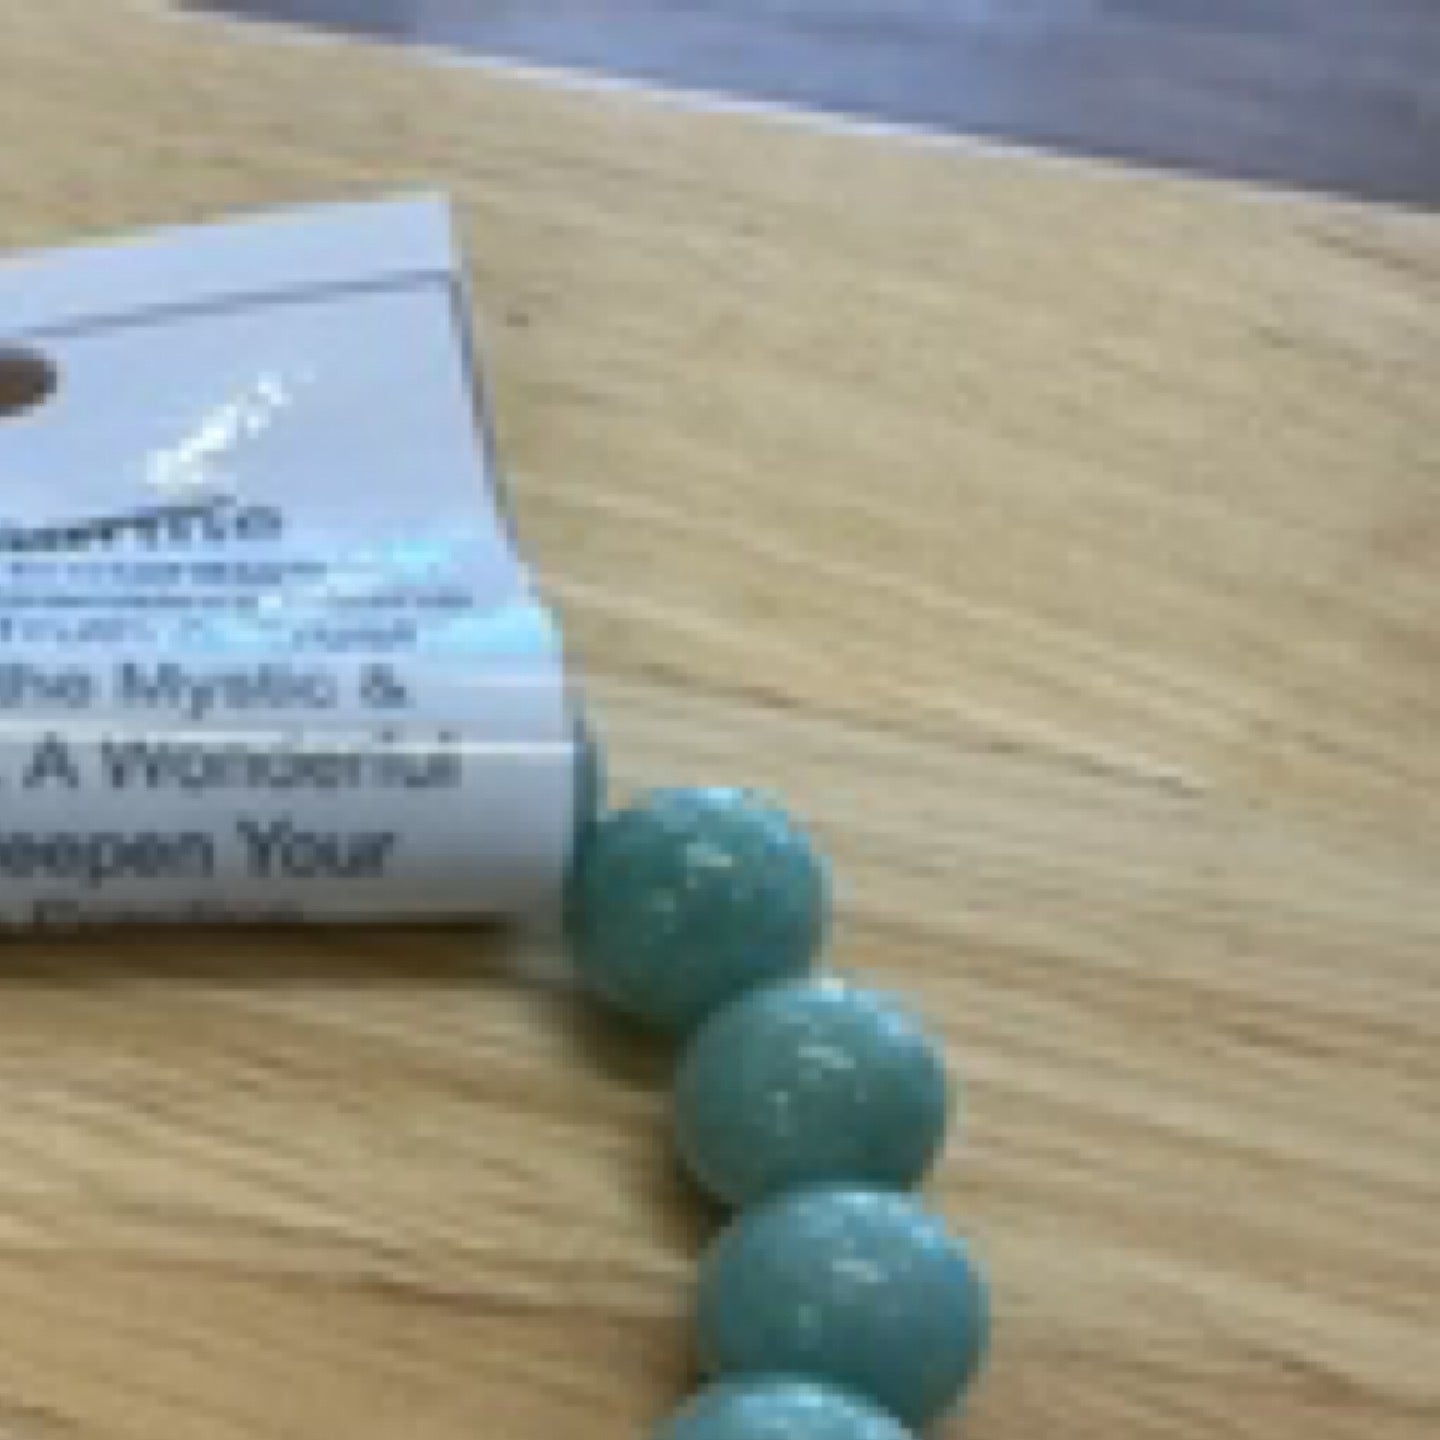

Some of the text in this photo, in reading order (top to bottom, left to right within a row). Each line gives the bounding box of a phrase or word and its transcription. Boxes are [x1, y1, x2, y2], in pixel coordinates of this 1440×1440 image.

[122, 662, 339, 720] Mystic
[360, 662, 410, 708] &
[22, 730, 80, 790] A
[235, 816, 396, 880] Your
